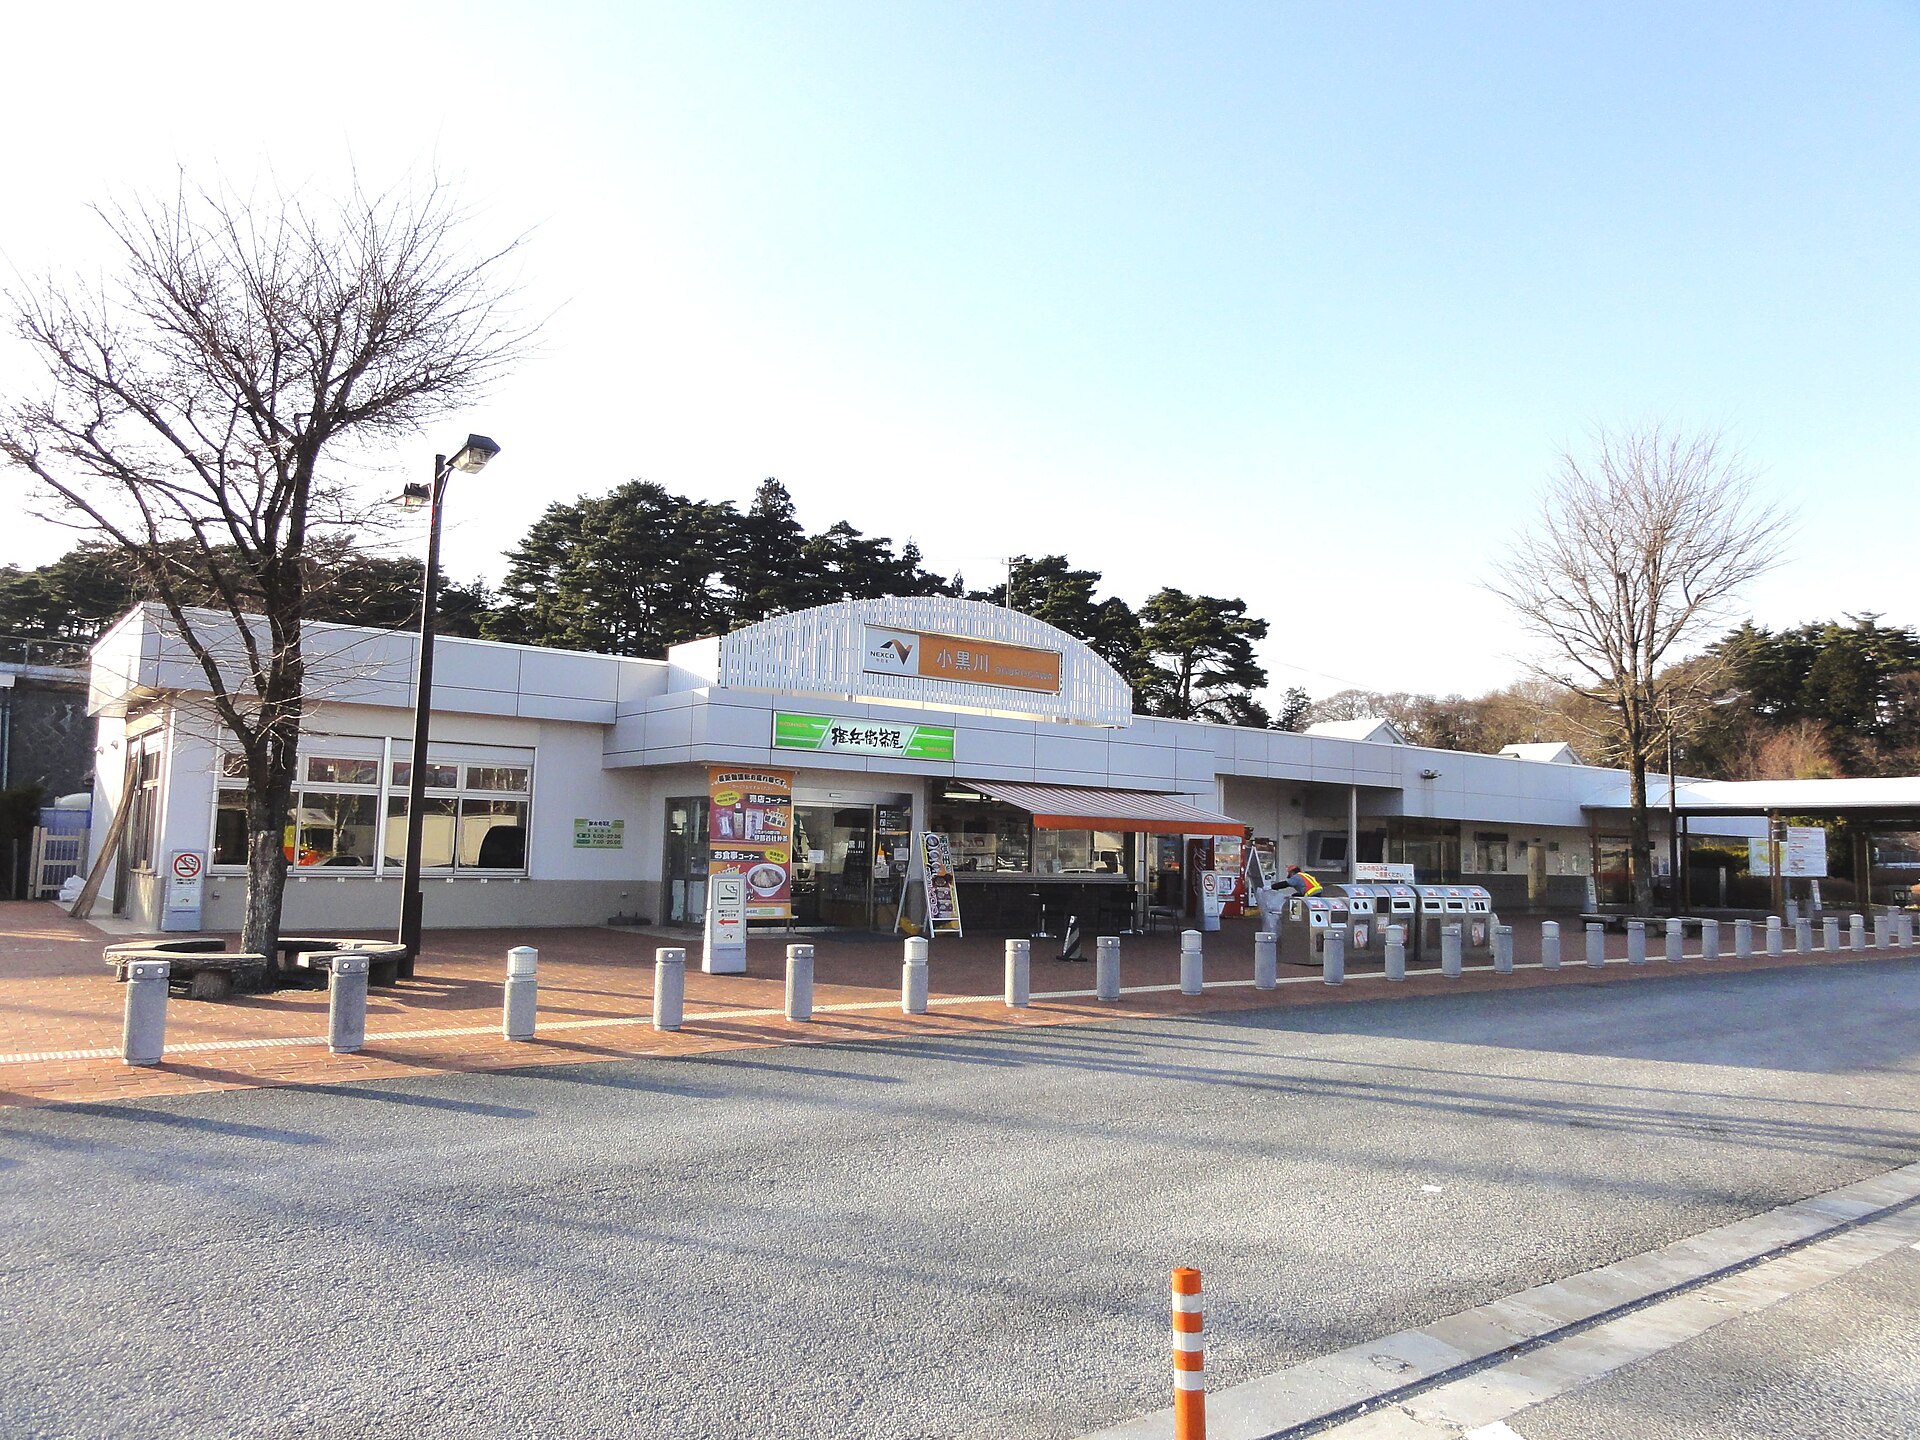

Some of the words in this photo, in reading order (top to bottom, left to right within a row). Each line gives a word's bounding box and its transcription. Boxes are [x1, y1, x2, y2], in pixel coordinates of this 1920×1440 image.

[870, 650, 895, 659] NEXCO
[936, 649, 989, 673] 小黒川
[749, 795, 788, 804] 売店コーナー
[714, 851, 760, 860] お食事コーナー
